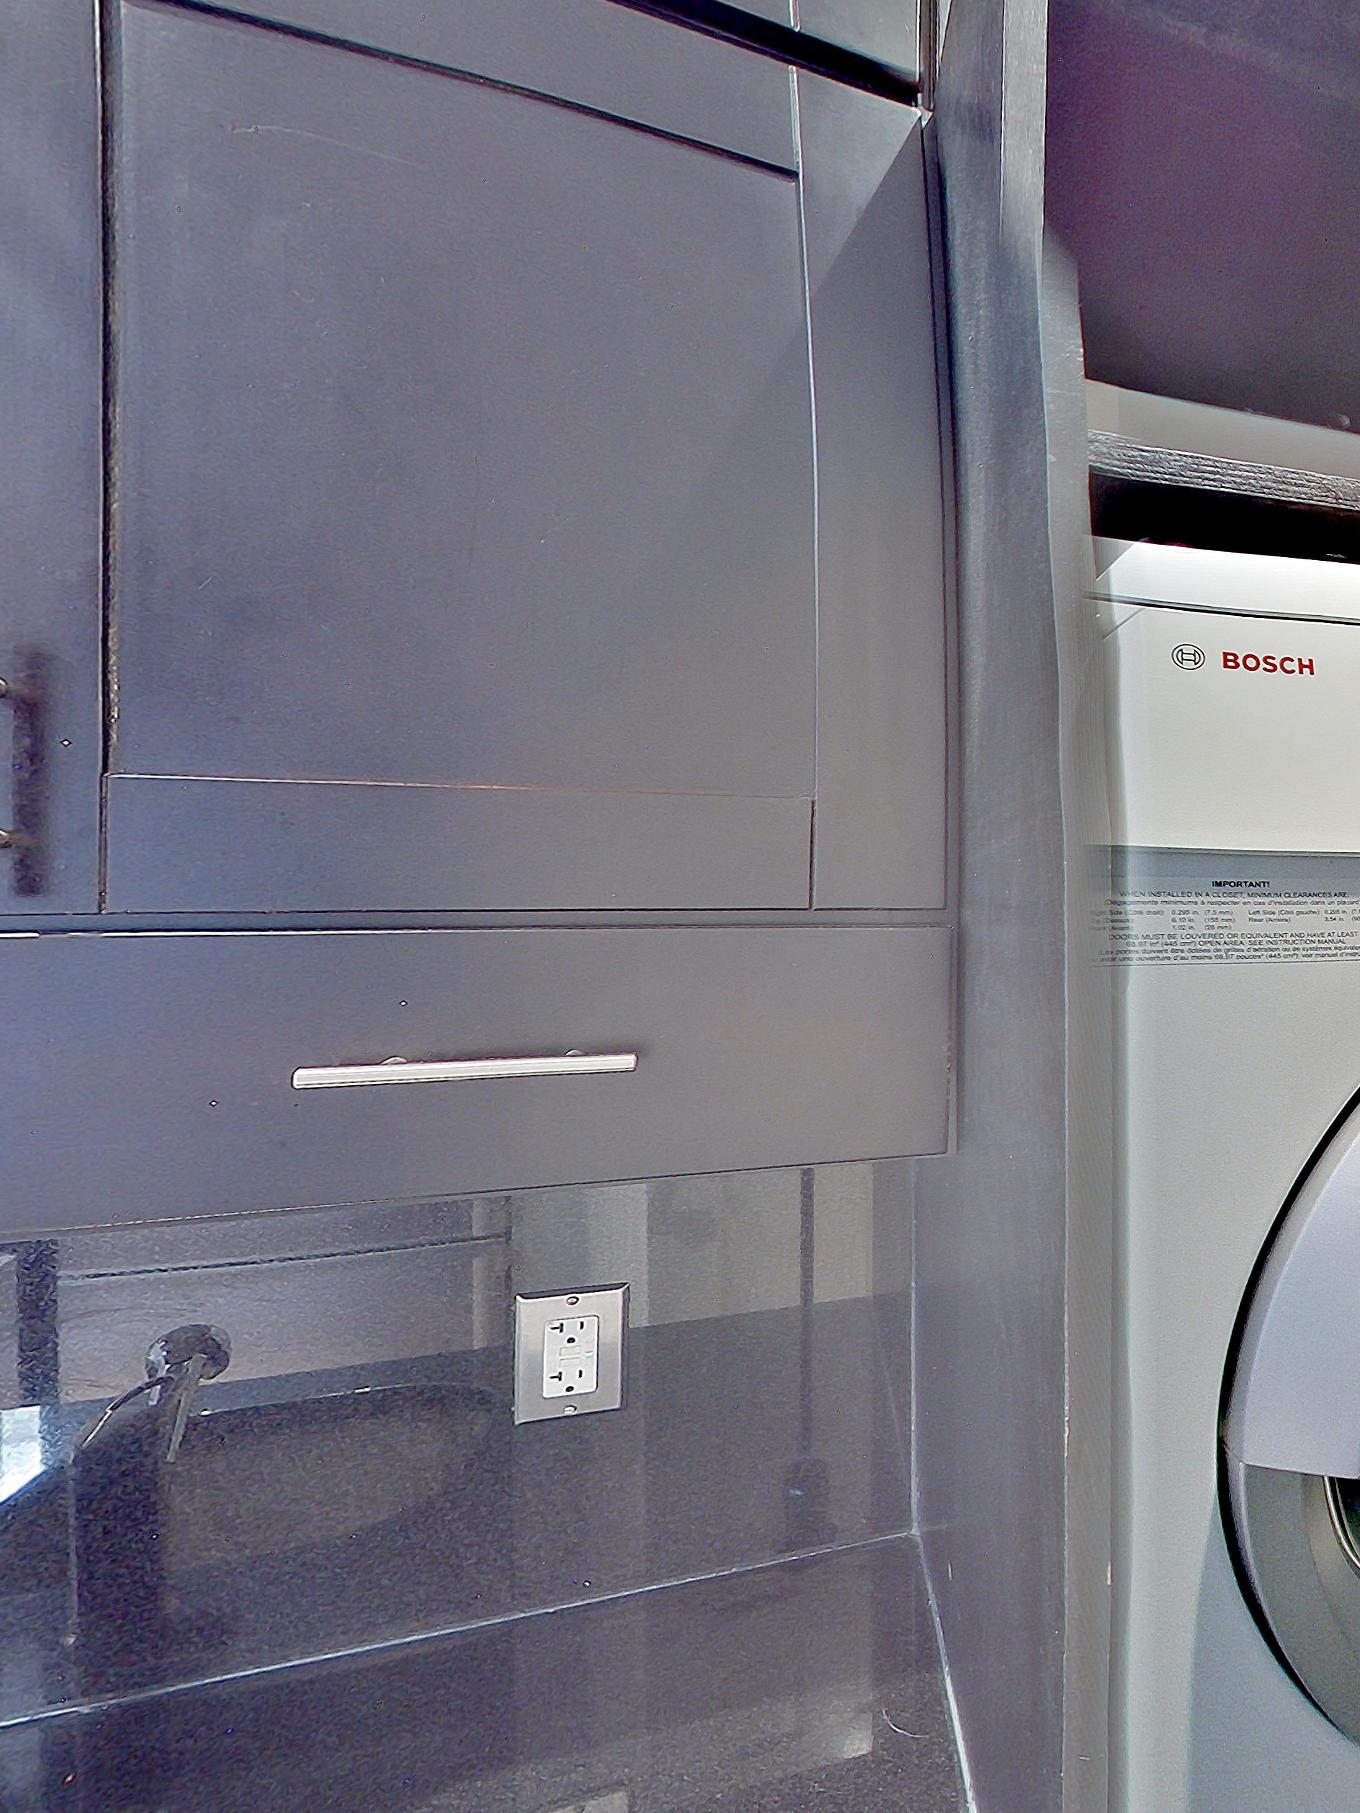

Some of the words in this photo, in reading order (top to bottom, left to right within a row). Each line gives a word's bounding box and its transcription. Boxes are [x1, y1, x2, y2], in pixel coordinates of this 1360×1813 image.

[1222, 651, 1315, 676] BOSCH
[1211, 880, 1271, 888] IMPORTANT!
[1118, 890, 1146, 898] WHEN
[1108, 933, 1139, 941] DOORS
